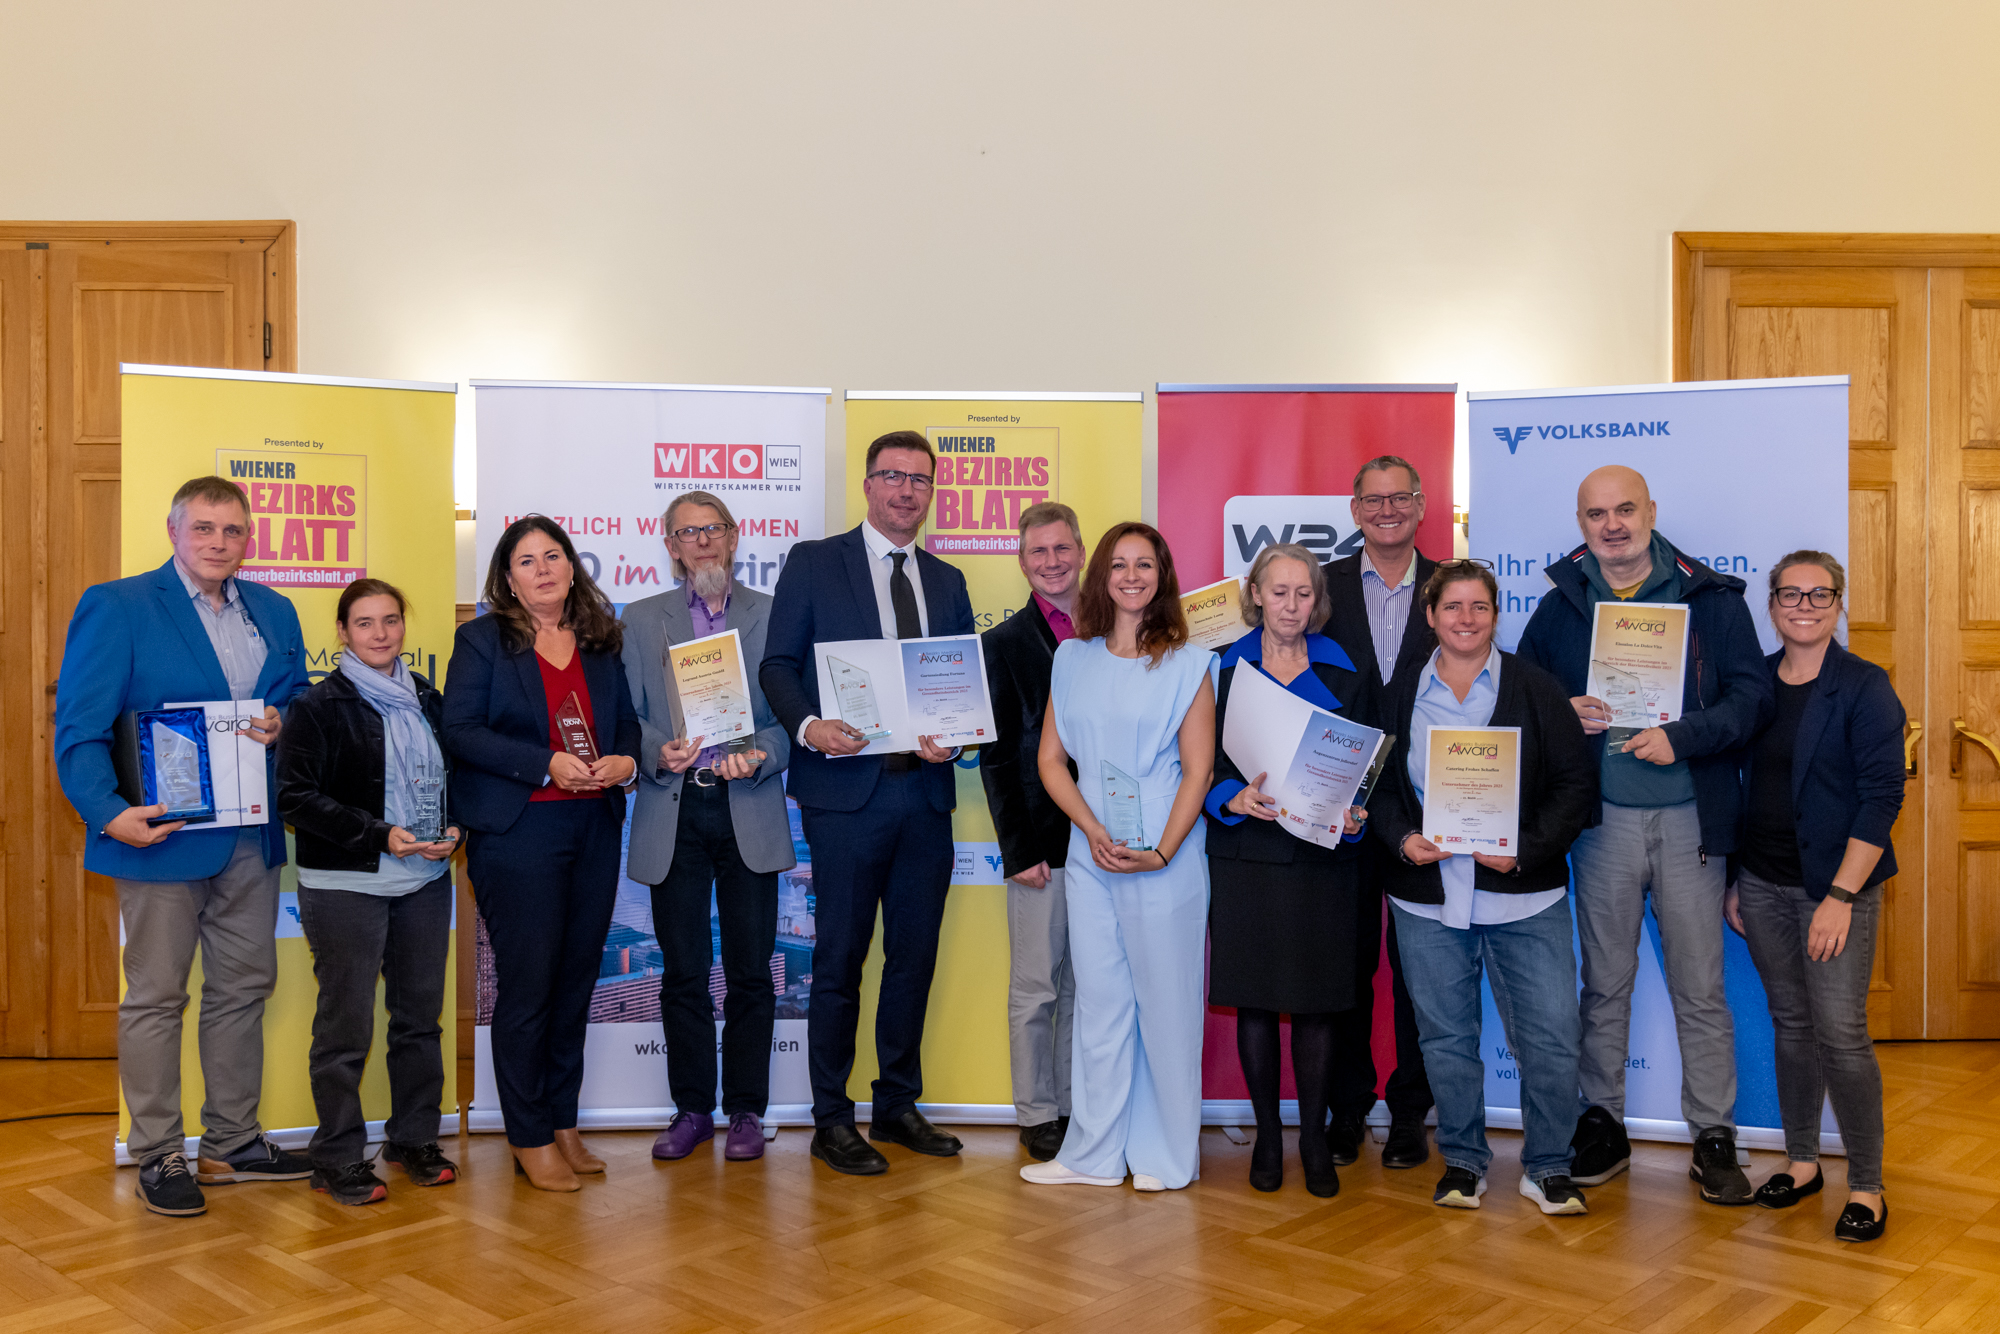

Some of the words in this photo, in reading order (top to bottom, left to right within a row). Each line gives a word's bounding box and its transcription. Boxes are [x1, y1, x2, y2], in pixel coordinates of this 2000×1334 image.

[1010, 415, 1020, 424] by
[1537, 420, 1670, 440] VOLKSBANK
[264, 438, 310, 448] Presented
[313, 440, 324, 450] by
[938, 436, 996, 452] WIENER
[230, 460, 296, 479] WIENER
[656, 447, 759, 474] WKO
[769, 458, 798, 468] WIEN
[936, 456, 1049, 486] BEZIRKS
[654, 482, 771, 491] WIRTSCHAFTSKAMMER
[504, 516, 621, 535] HZLICH
[614, 554, 660, 586] im
[1498, 554, 1536, 576] Ihr
[235, 568, 356, 586] ienerbezirksblatt.at
[1186, 593, 1226, 614] Award
[1616, 617, 1666, 632] Award
[306, 648, 421, 666] Meal
[680, 649, 722, 669] Award
[919, 651, 963, 664] Award
[1322, 729, 1365, 751] Award
[1448, 742, 1498, 756] Award
